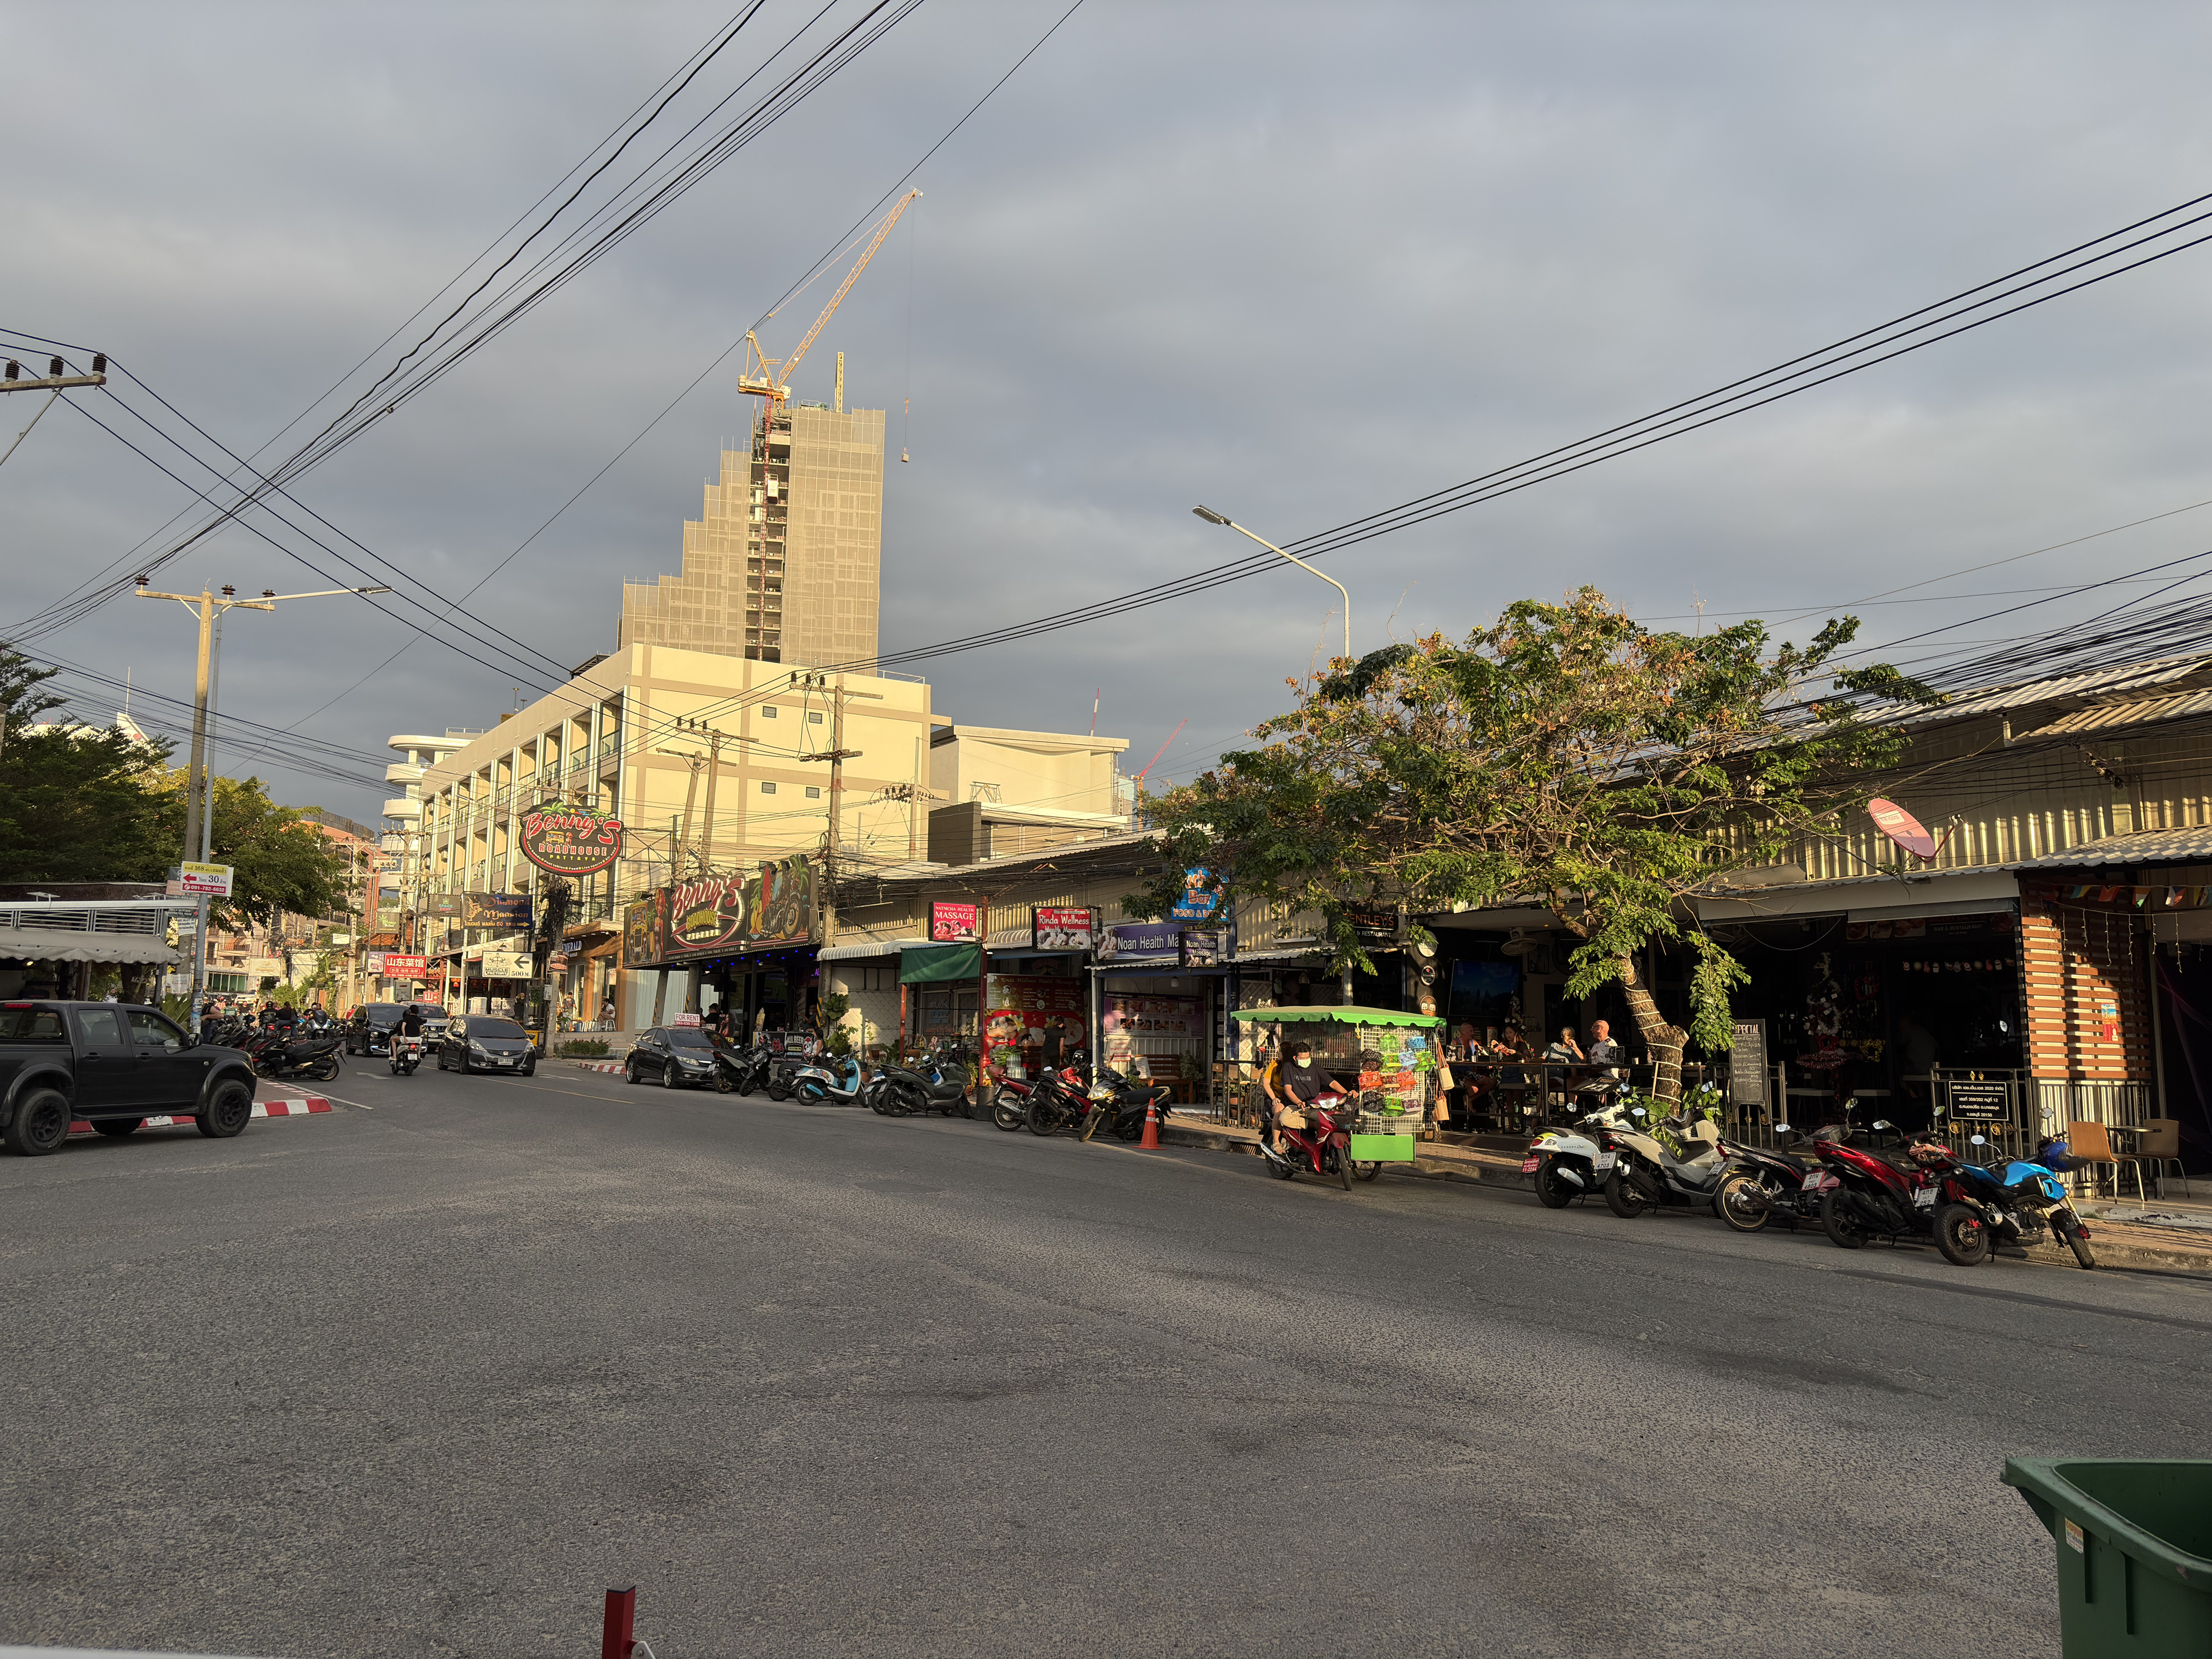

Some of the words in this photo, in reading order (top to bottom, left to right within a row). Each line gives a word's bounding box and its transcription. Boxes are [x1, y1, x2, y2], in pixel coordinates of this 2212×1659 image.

[539, 843, 607, 856] ROADHOUSE
[208, 875, 220, 883] 30
[483, 897, 531, 907] Diamond
[1188, 890, 1211, 905] Bar
[935, 911, 974, 920] MASSAGE
[1173, 909, 1194, 917] FOOD
[686, 910, 718, 931] ROADHOUSE
[1038, 914, 1058, 925] Rinda
[1061, 914, 1089, 925] Wellness
[1045, 925, 1061, 935] Health
[1063, 926, 1086, 935] Massage
[562, 940, 582, 952] EMERALD
[1117, 937, 1136, 951] Noan
[1140, 935, 1164, 950] Health
[1192, 949, 1211, 958] Massage
[387, 957, 425, 968] 山东菜馆
[794, 1035, 804, 1044] BEER
[804, 1040, 812, 1054] 39
